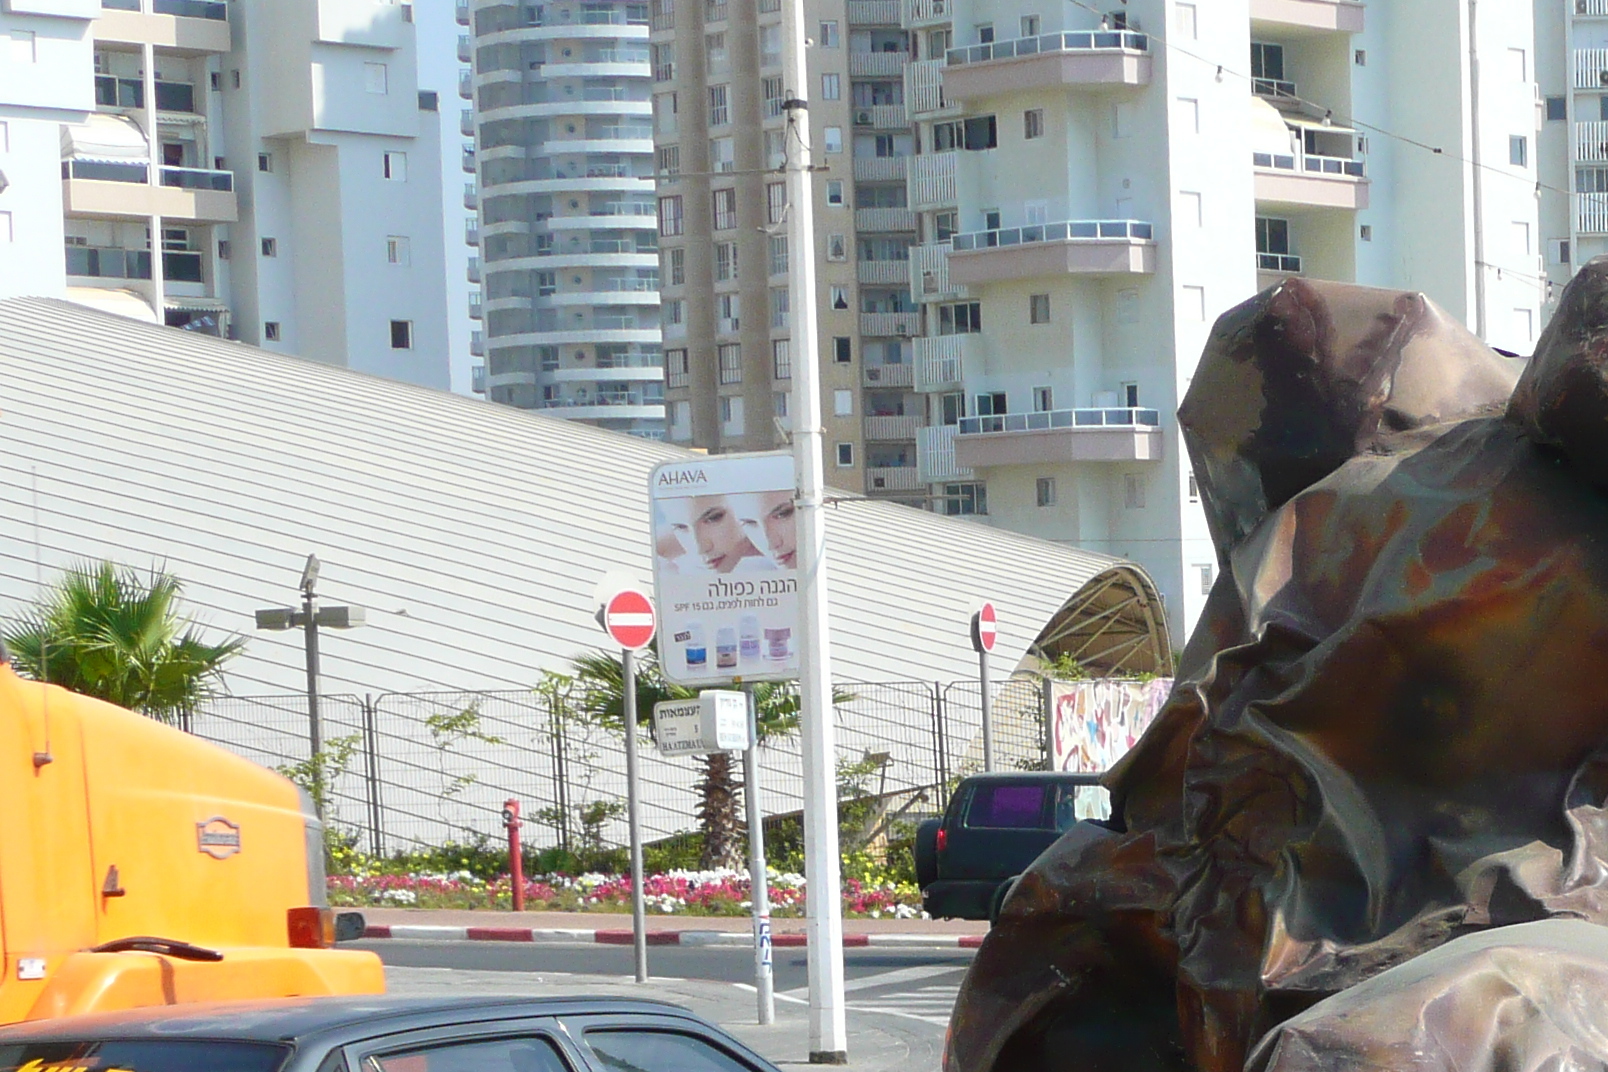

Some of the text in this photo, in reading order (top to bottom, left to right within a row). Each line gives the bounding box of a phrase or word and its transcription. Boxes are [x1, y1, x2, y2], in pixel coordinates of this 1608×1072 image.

[658, 470, 708, 486] AHAVA
[708, 577, 798, 597] הגנה כפולה
[674, 603, 689, 612] SPF
[692, 602, 701, 611] 15
[660, 705, 700, 719] עצמאות
